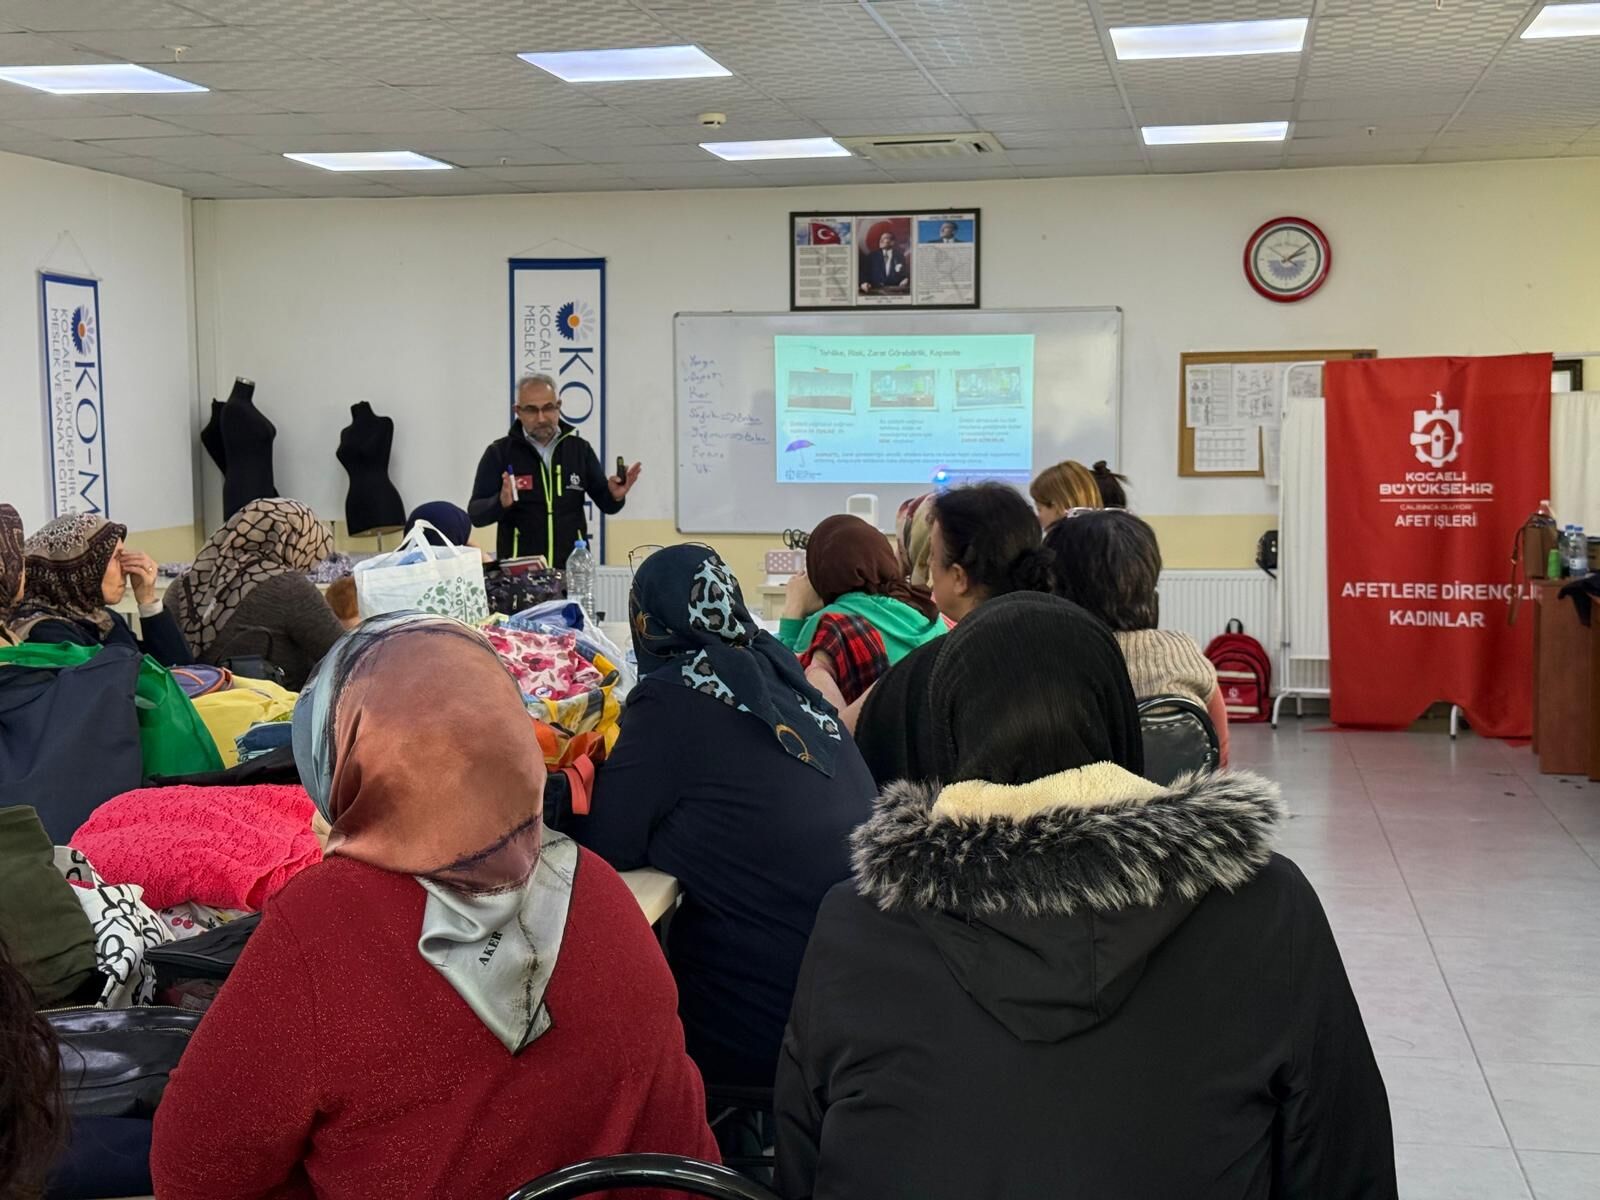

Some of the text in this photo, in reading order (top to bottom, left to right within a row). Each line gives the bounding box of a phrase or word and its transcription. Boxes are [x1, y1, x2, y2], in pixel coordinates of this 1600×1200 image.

[60, 308, 72, 382] KOCAELİ
[524, 305, 536, 358] MESLEK
[539, 304, 552, 371] KOCAELİ
[51, 307, 68, 513] MESLEK VE SANAT EĞİTİM
[1379, 483, 1494, 495] BÜYÜKŞEHİR
[1405, 471, 1466, 482] KOCAELİ
[1395, 512, 1477, 529] AFET İŞLERİ
[1341, 582, 1438, 599] AFETLERE
[1389, 610, 1486, 628] KADINLAR
[478, 930, 503, 966] AKER
